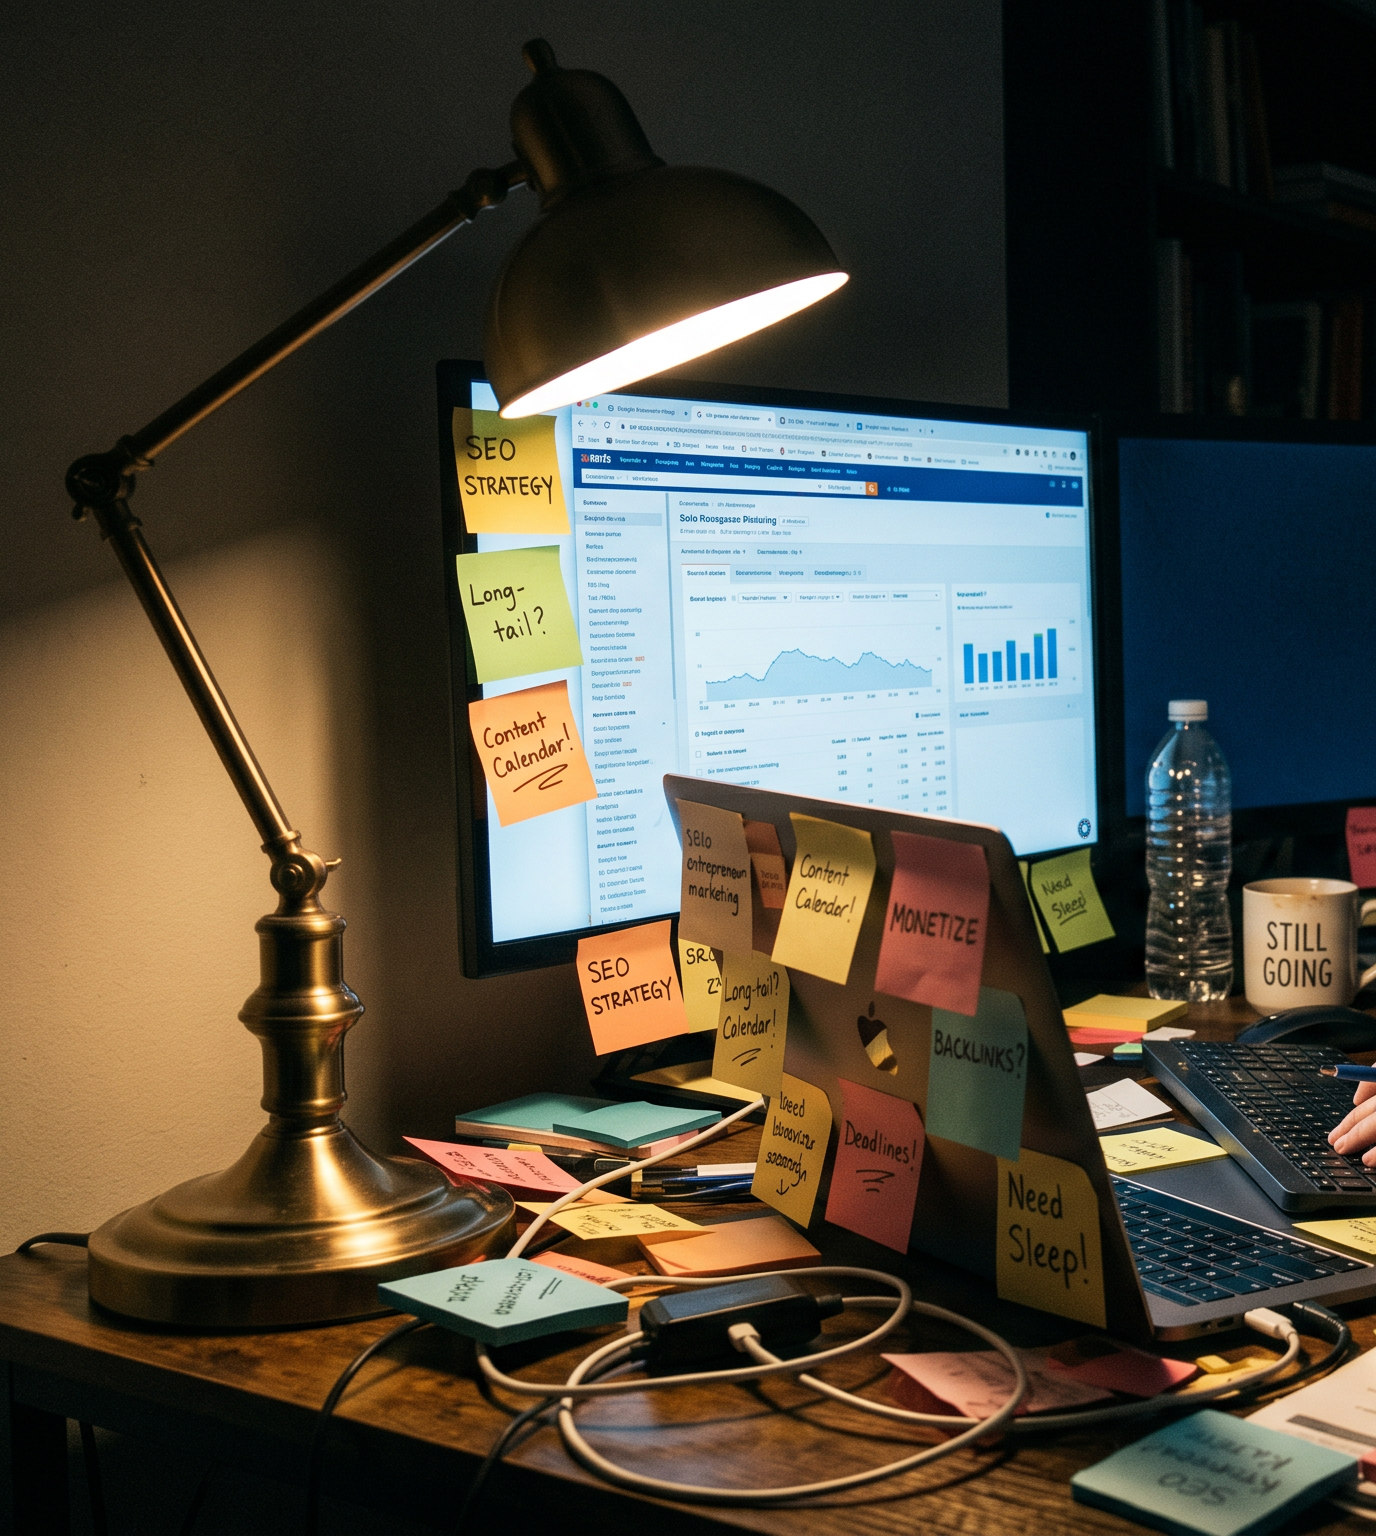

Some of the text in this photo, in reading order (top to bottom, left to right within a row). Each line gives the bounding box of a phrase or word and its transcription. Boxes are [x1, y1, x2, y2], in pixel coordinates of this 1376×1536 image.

[465, 434, 516, 461] SEO
[464, 474, 553, 505] STRATEGY
[469, 583, 525, 612] Long-
[493, 605, 546, 642] tail?
[483, 711, 547, 749] Content
[493, 722, 574, 778] Calendar!
[800, 853, 849, 886] Content
[688, 883, 739, 916] marketing
[889, 902, 979, 946] MONETIZE
[1267, 921, 1328, 952] STILL
[587, 957, 630, 984] SEO
[1263, 956, 1333, 988] GOING
[591, 976, 672, 1015] STRATEGY
[725, 971, 779, 1011] Long-tail?
[934, 1029, 1026, 1079] BACKLINKS?
[845, 1119, 917, 1173] Deadlines!
[1008, 1170, 1063, 1219] Need
[1009, 1224, 1089, 1289] Sleep!
